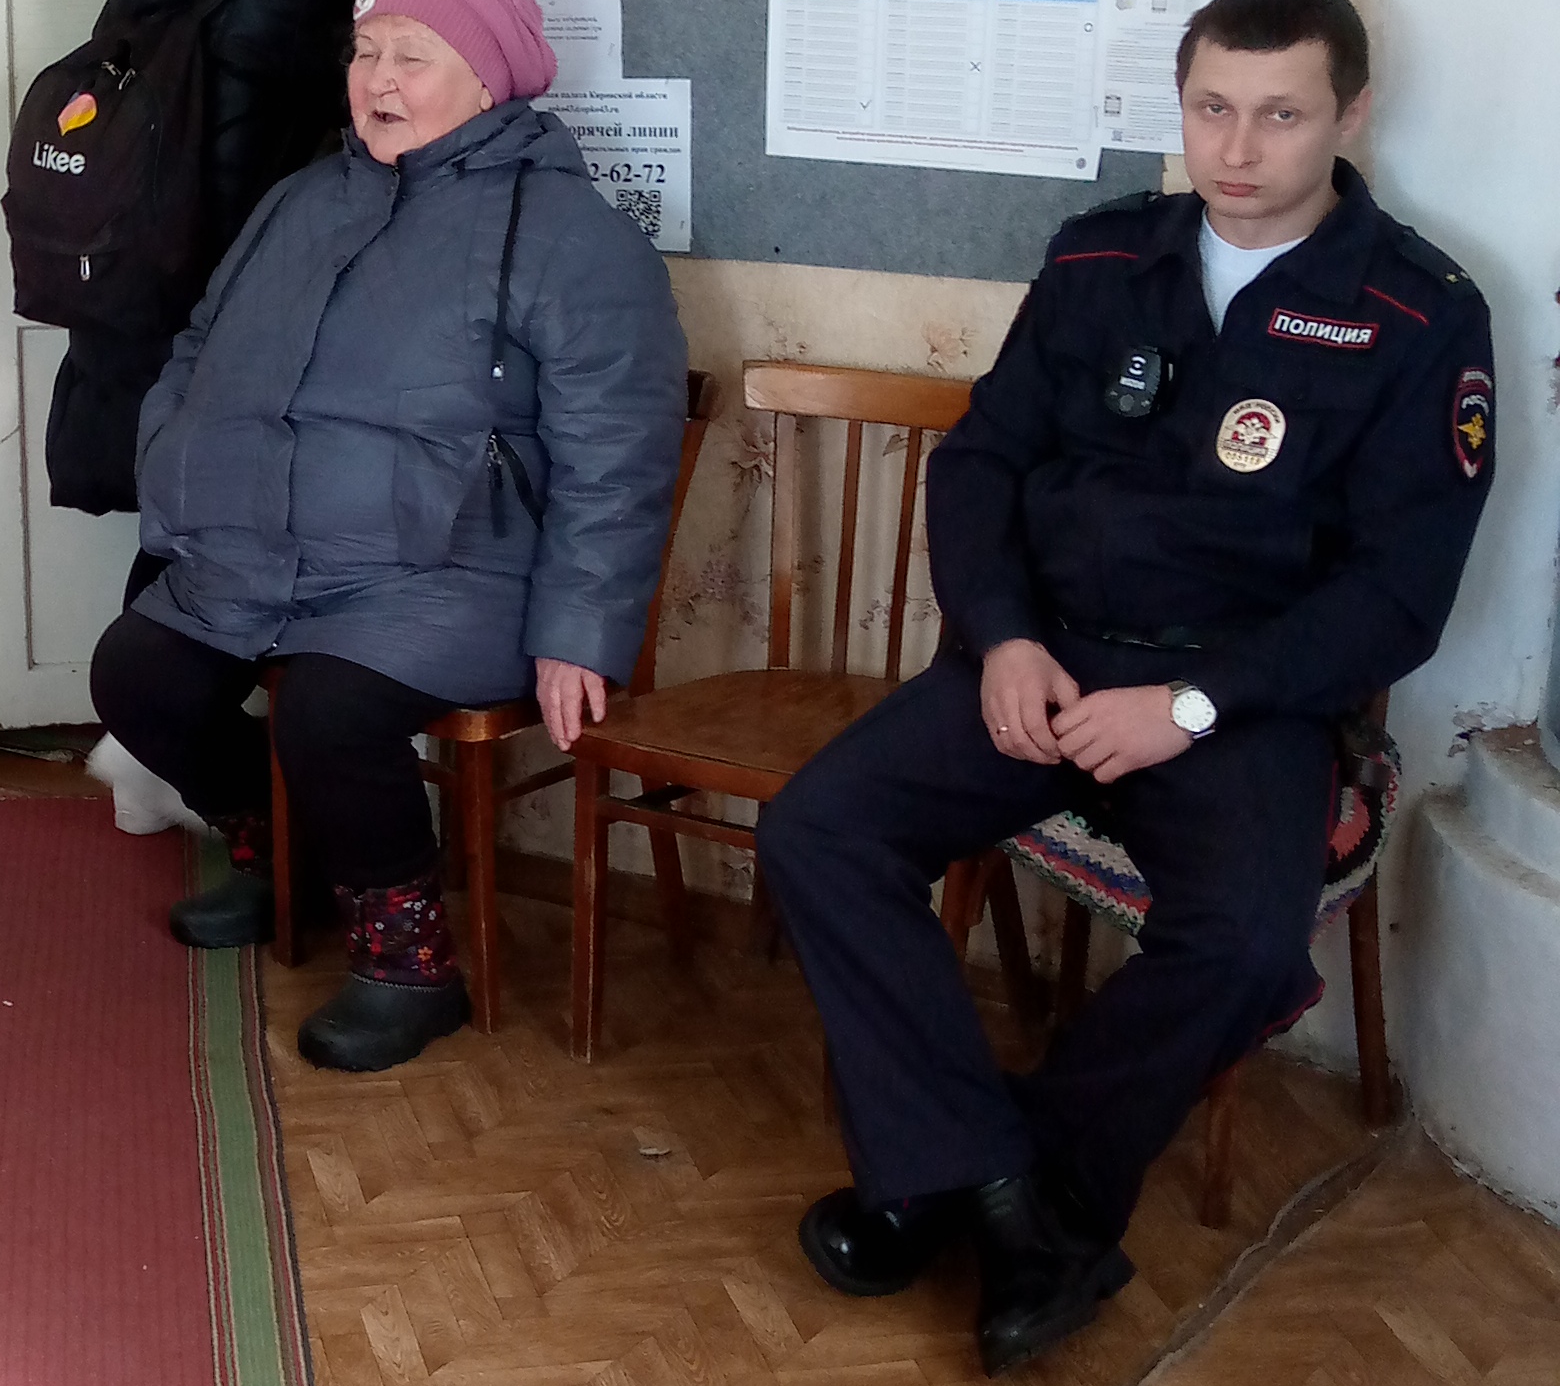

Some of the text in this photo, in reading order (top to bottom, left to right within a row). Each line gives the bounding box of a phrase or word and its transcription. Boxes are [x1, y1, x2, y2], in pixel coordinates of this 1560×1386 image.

[567, 122, 679, 141] орячей линии
[32, 140, 86, 175] Likee
[590, 163, 666, 183] 2-62-72
[1274, 314, 1373, 344] ПОЛИЦИЯ
